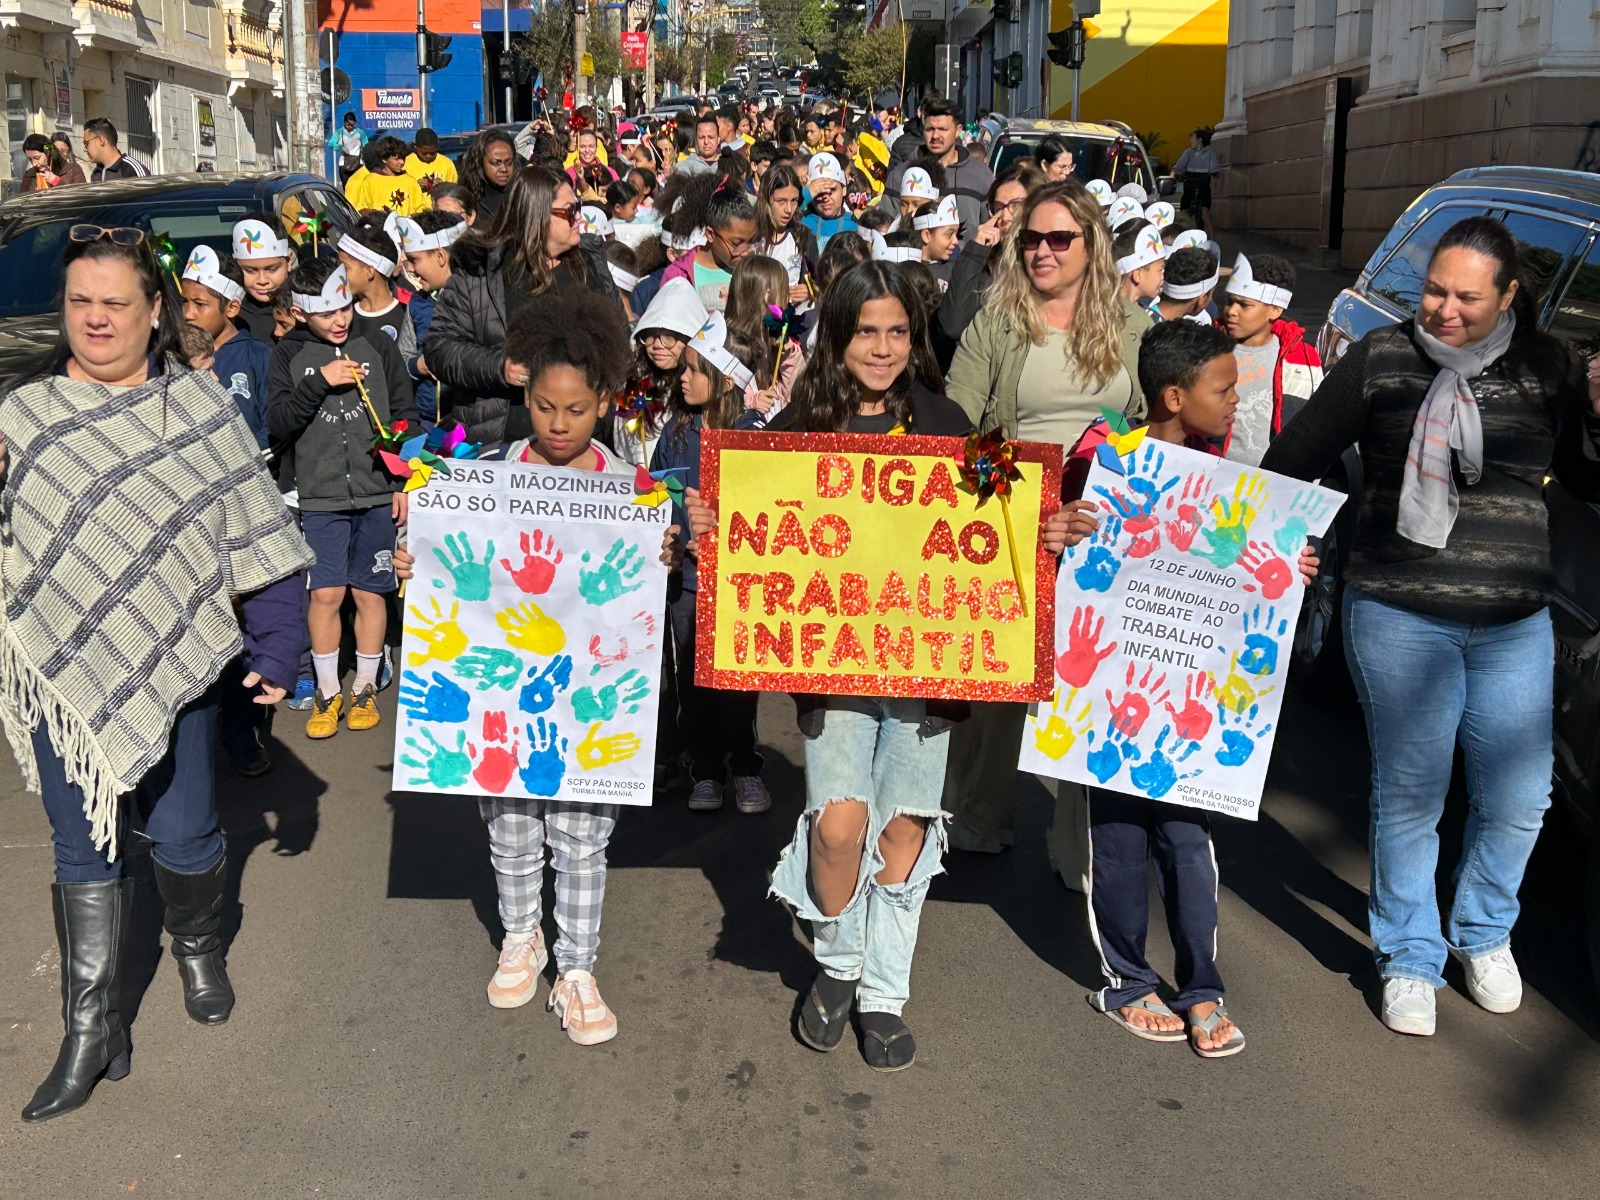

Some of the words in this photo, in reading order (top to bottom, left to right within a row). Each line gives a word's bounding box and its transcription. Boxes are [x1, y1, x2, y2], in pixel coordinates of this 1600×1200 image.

[378, 94, 412, 105] TRADIÇÃO
[365, 112, 420, 120] ESTACIONAMENT
[377, 120, 414, 128] EXCLUSIVO
[429, 466, 495, 485] ESSAS
[510, 471, 632, 495] MÃOZINHAS
[816, 454, 959, 509] DIGA
[416, 489, 461, 510] SÃO
[467, 493, 497, 513] SÓ
[509, 499, 565, 517] PARA
[569, 502, 667, 524] BRINCAR!
[728, 498, 852, 559] NÃO
[921, 517, 1000, 565] AO
[1149, 558, 1165, 571] 12
[1166, 562, 1188, 577] DE
[1188, 568, 1237, 589] JUNHO
[726, 568, 1023, 624] TRABALHO
[1127, 579, 1150, 595] DIA
[1154, 585, 1215, 610] MUNDIAL
[1218, 600, 1240, 615] DO
[1125, 596, 1194, 622] COMBATE
[1202, 613, 1224, 628] AO
[733, 619, 1010, 675] INFANTIL
[1121, 615, 1214, 650] TRABALHO
[1123, 640, 1199, 670] INFANTIL
[567, 778, 591, 786] SCFV
[592, 779, 612, 788] PÃO
[614, 781, 646, 790] NOSSO
[572, 787, 596, 795] TURMA
[1176, 784, 1201, 796] SCFV
[1202, 789, 1222, 801] PÃO
[1223, 794, 1255, 808] NOSSO
[1181, 795, 1205, 805] TURMA
[1206, 800, 1216, 808] DA
[1217, 803, 1239, 812] TARDE
